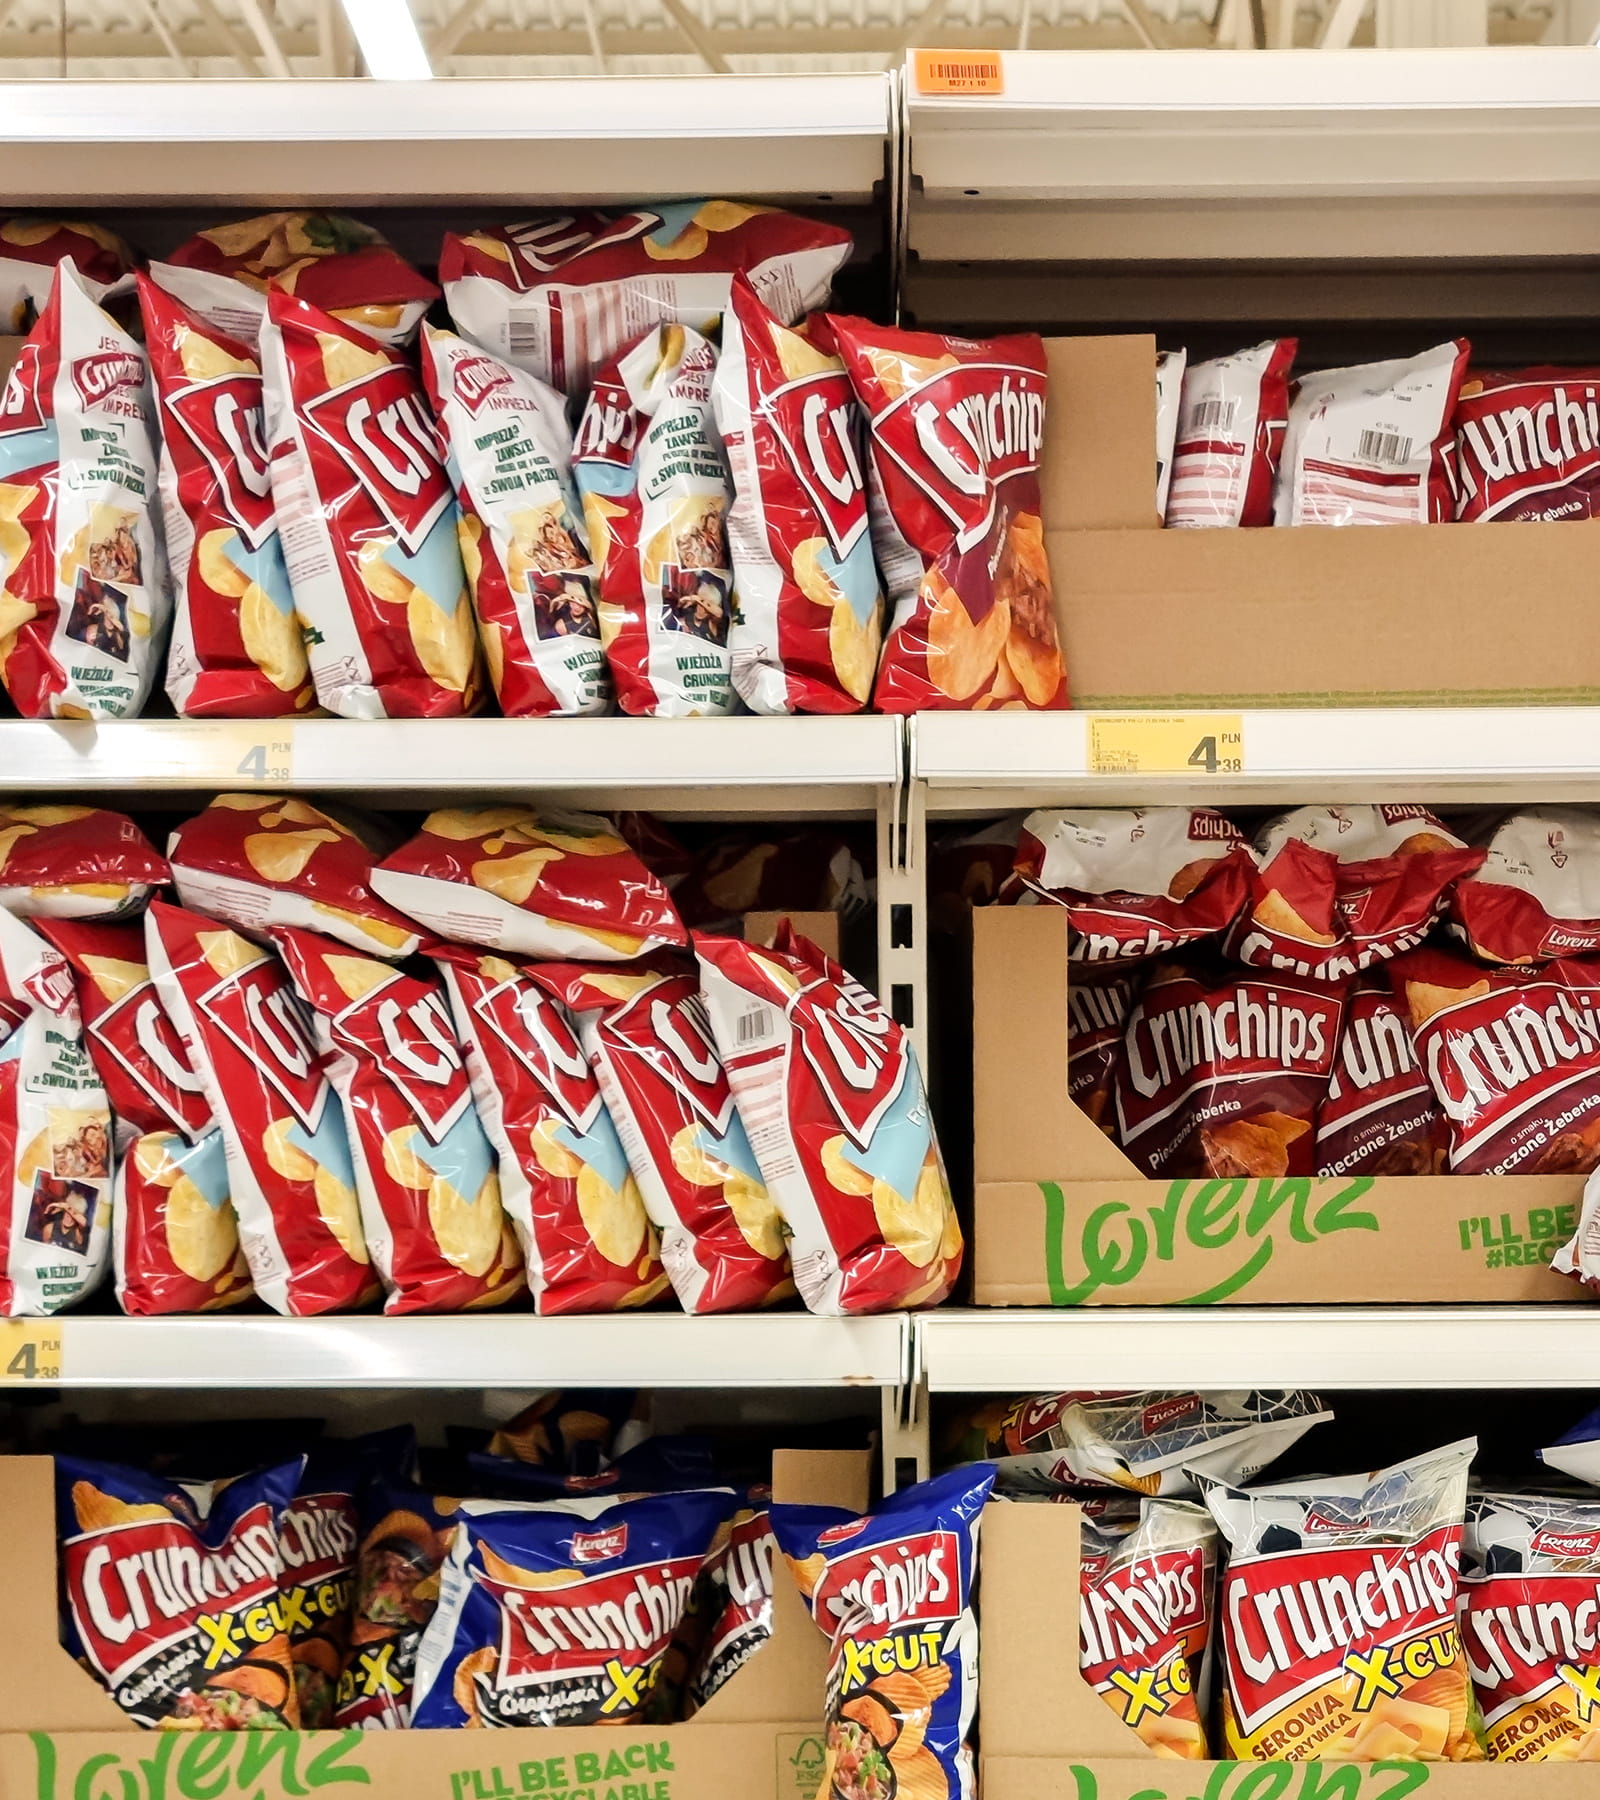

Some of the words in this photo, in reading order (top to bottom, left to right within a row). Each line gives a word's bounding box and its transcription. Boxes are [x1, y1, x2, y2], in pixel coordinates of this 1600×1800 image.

[237, 745, 269, 780] 4
[1188, 736, 1221, 773] 4
[1221, 733, 1241, 743] PLN
[1223, 759, 1241, 772] 38
[1547, 929, 1599, 949] Lorenz
[1122, 991, 1327, 1099] Crunchips
[1042, 1177, 1379, 1305] Lorenz
[1459, 1216, 1519, 1251] I'LL
[1528, 1205, 1575, 1239] BE
[7, 1343, 39, 1379] 4
[42, 1340, 61, 1351] PLN
[42, 1366, 59, 1379] 38
[575, 1532, 621, 1556] Lorenz
[1538, 1531, 1595, 1556] Lorenz
[1230, 1537, 1462, 1681] Crunchips
[842, 1630, 945, 1694] X-CUT
[1252, 1692, 1344, 1761] SEROWA
[1487, 1700, 1570, 1760] SEROWA
[520, 1761, 566, 1790] BE
[575, 1740, 675, 1784] BACK
